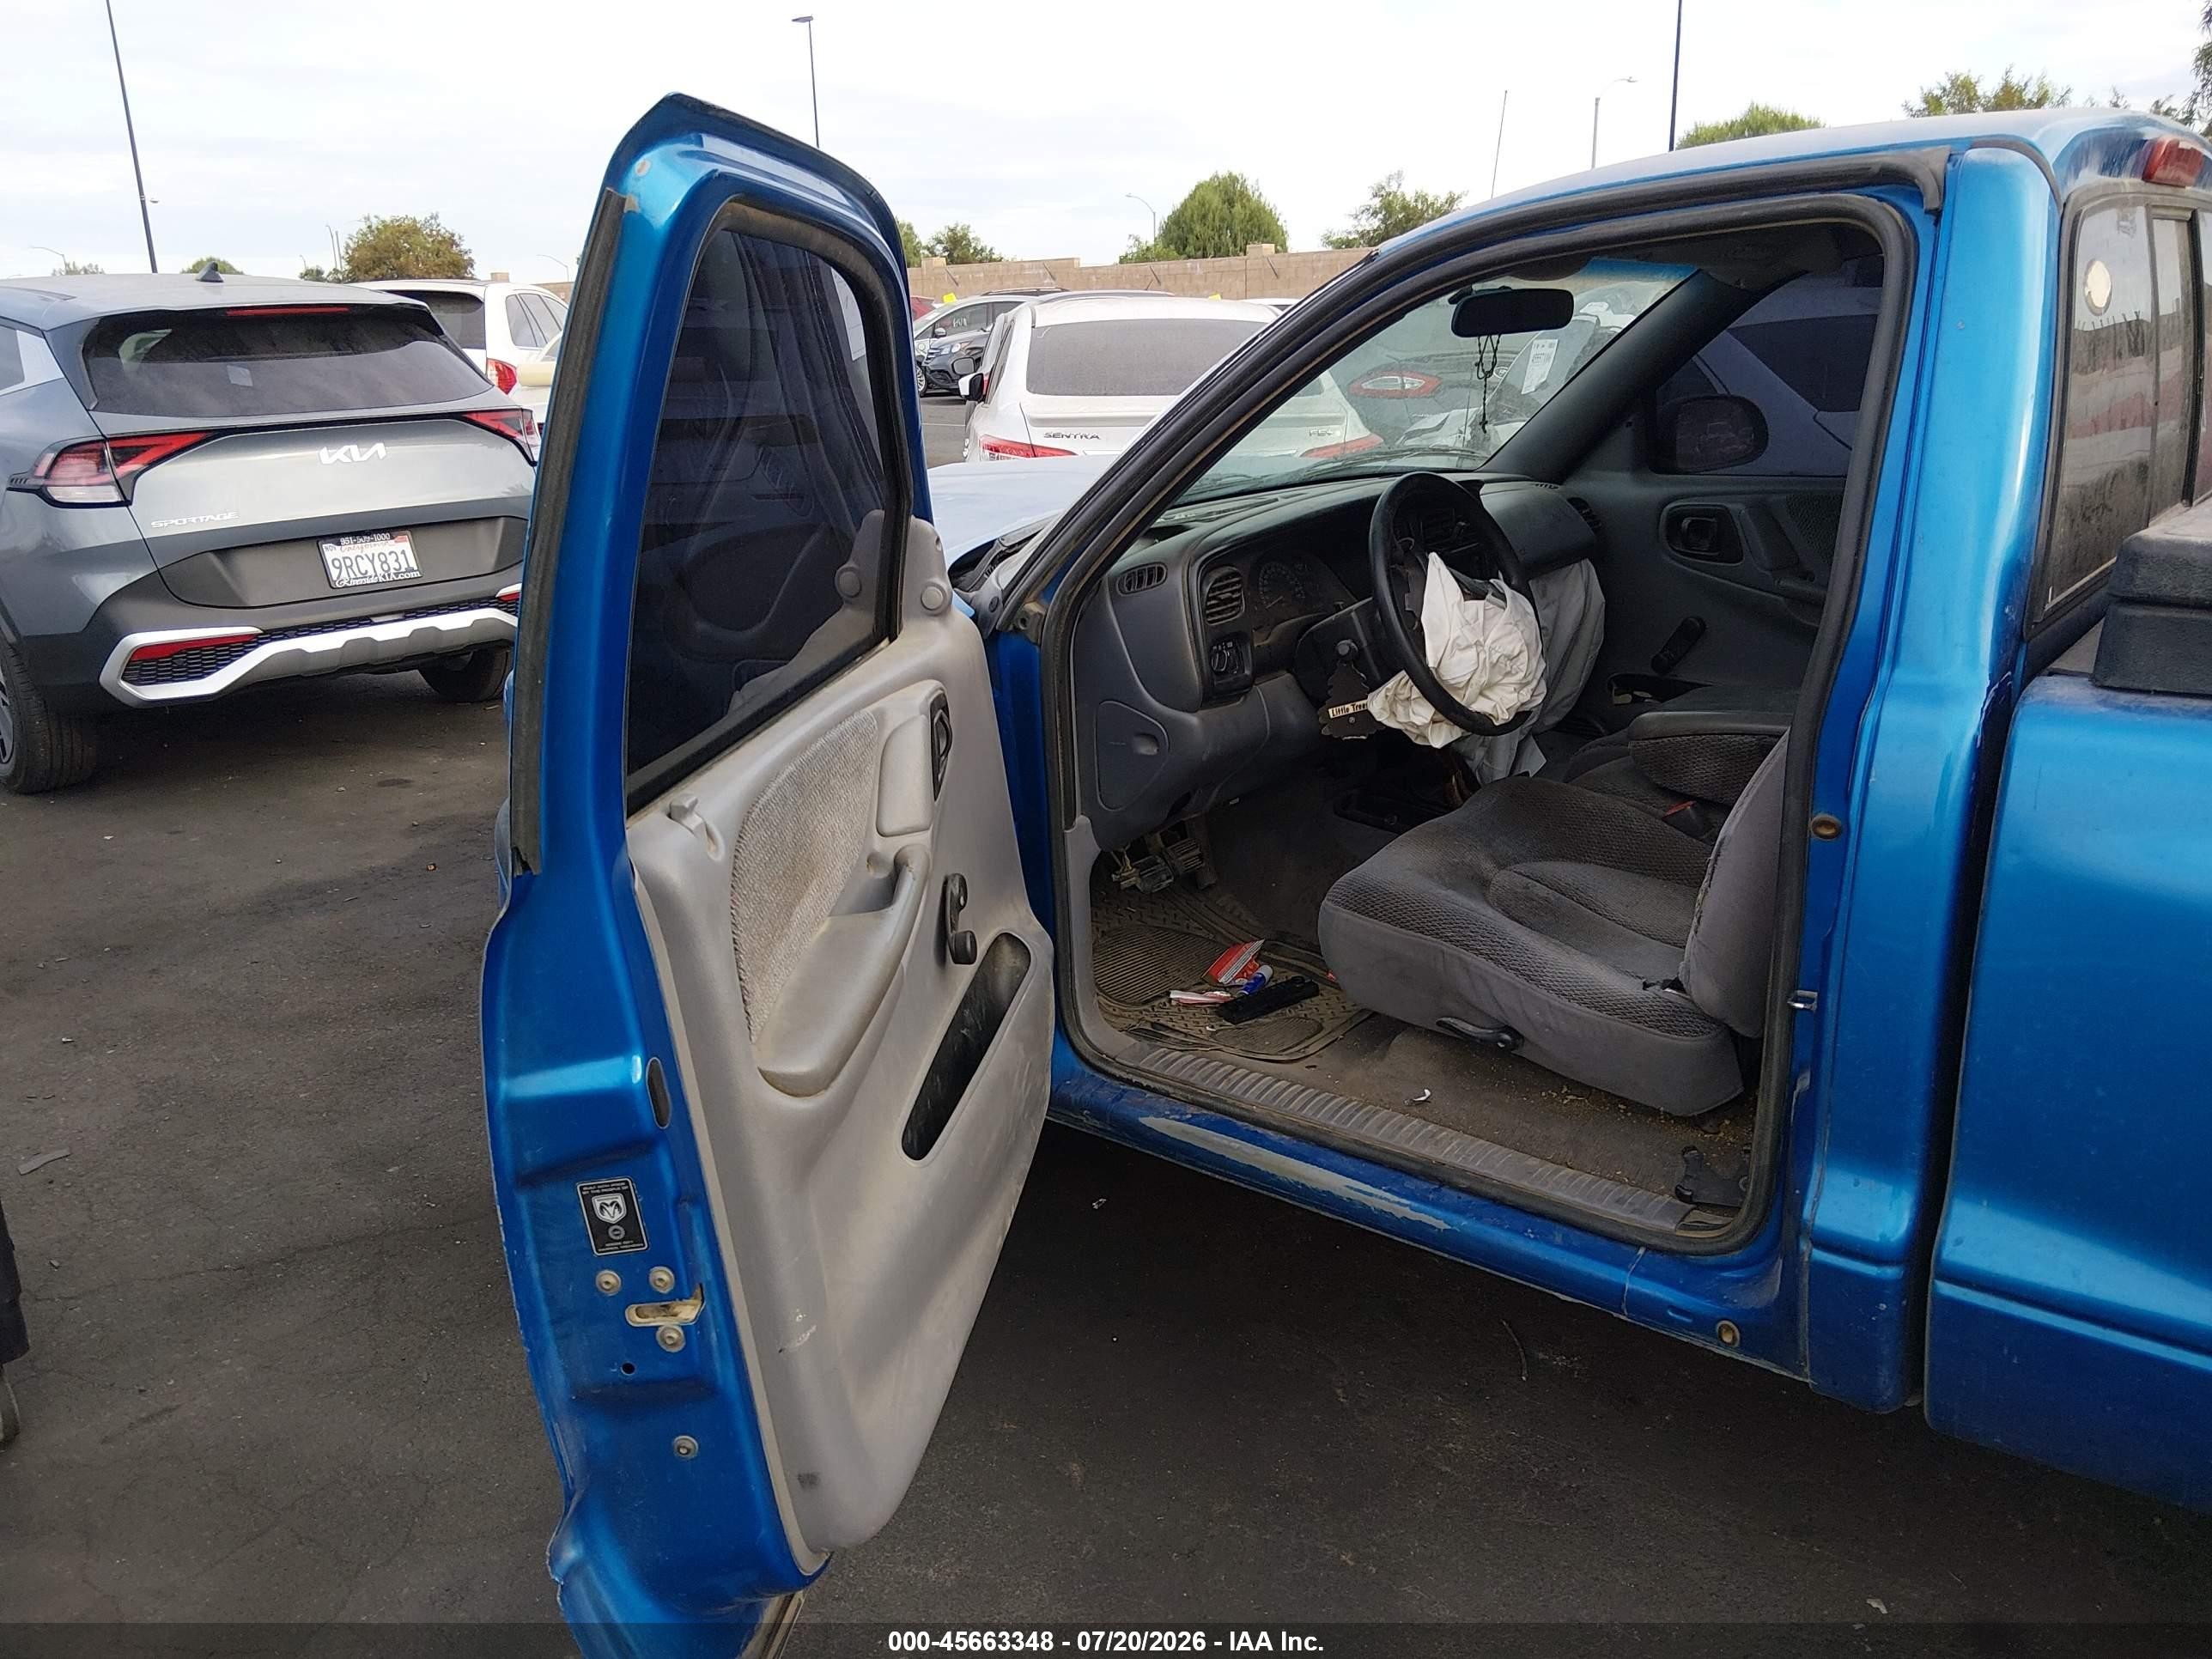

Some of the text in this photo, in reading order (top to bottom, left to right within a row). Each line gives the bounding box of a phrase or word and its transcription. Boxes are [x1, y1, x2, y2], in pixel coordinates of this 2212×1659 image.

[1043, 431, 1101, 440] SENTRA
[318, 442, 386, 465] KIA
[150, 511, 239, 529] SPORTAGE
[331, 550, 411, 580] 9RCY831
[1331, 706, 1350, 716] Little
